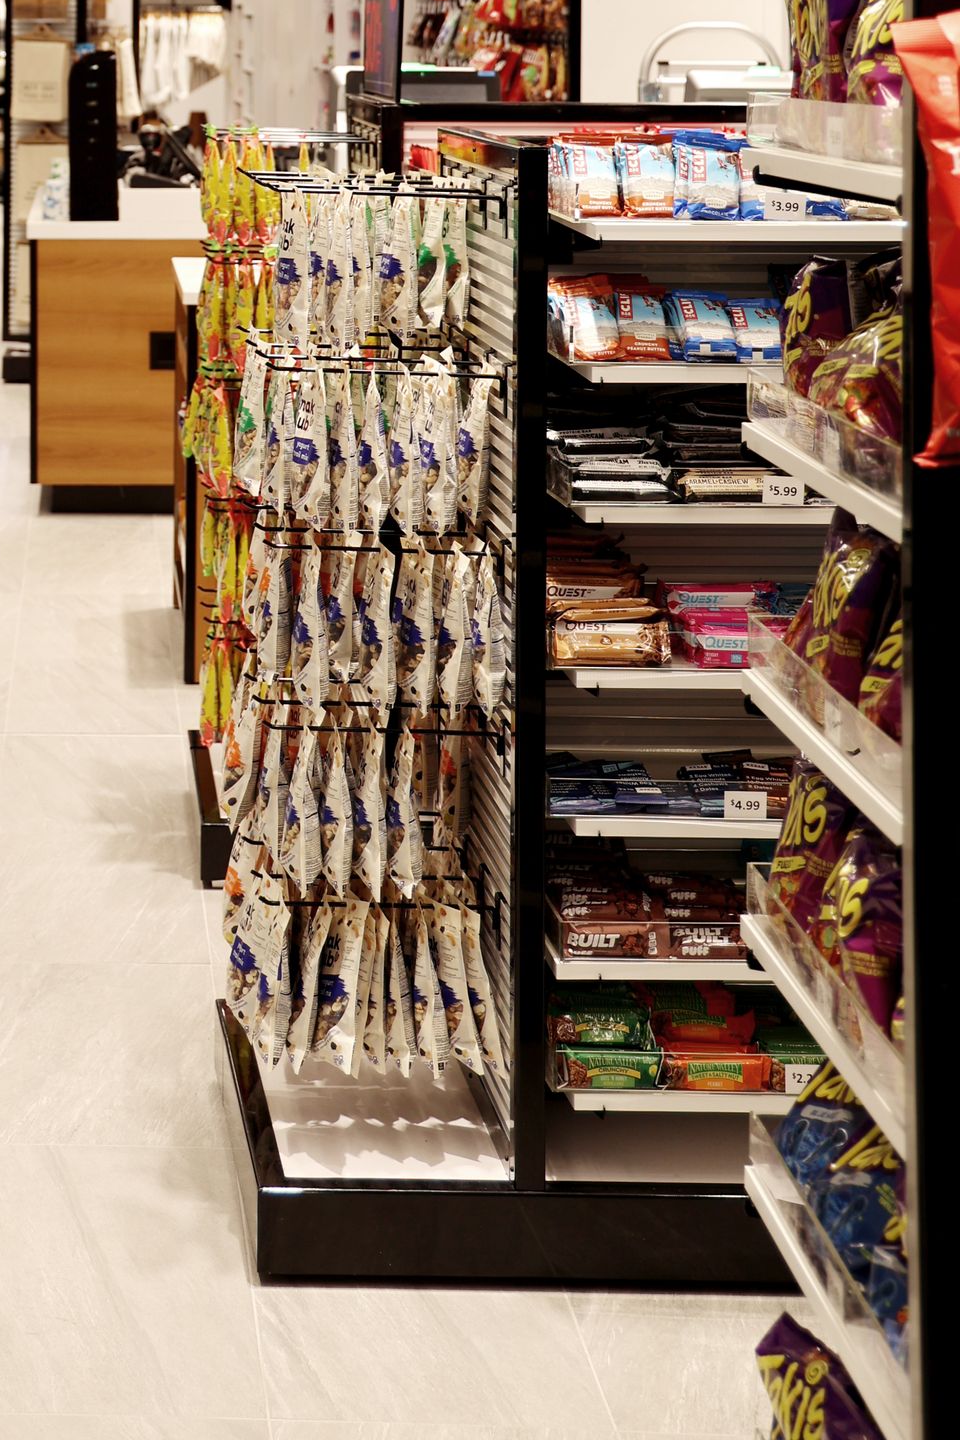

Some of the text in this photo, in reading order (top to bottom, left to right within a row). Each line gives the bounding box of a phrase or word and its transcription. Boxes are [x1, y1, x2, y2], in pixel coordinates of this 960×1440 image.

[771, 200, 799, 212] $3.99
[769, 485, 798, 497] $5.99
[546, 585, 587, 597] QUEST
[678, 592, 720, 603] QUEST
[565, 622, 608, 632] QUEST
[705, 636, 746, 649] QUEST
[731, 799, 760, 810] $4.99
[649, 875, 673, 885] PUFF
[671, 891, 697, 901] PUFF
[664, 908, 690, 918] PUFF
[567, 931, 620, 948] BUILT
[681, 946, 710, 956] PUFF
[588, 1056, 638, 1070] NATURE VALLEY
[689, 1062, 740, 1075] NATURE VALLEY
[792, 1072, 812, 1084] $2.2
